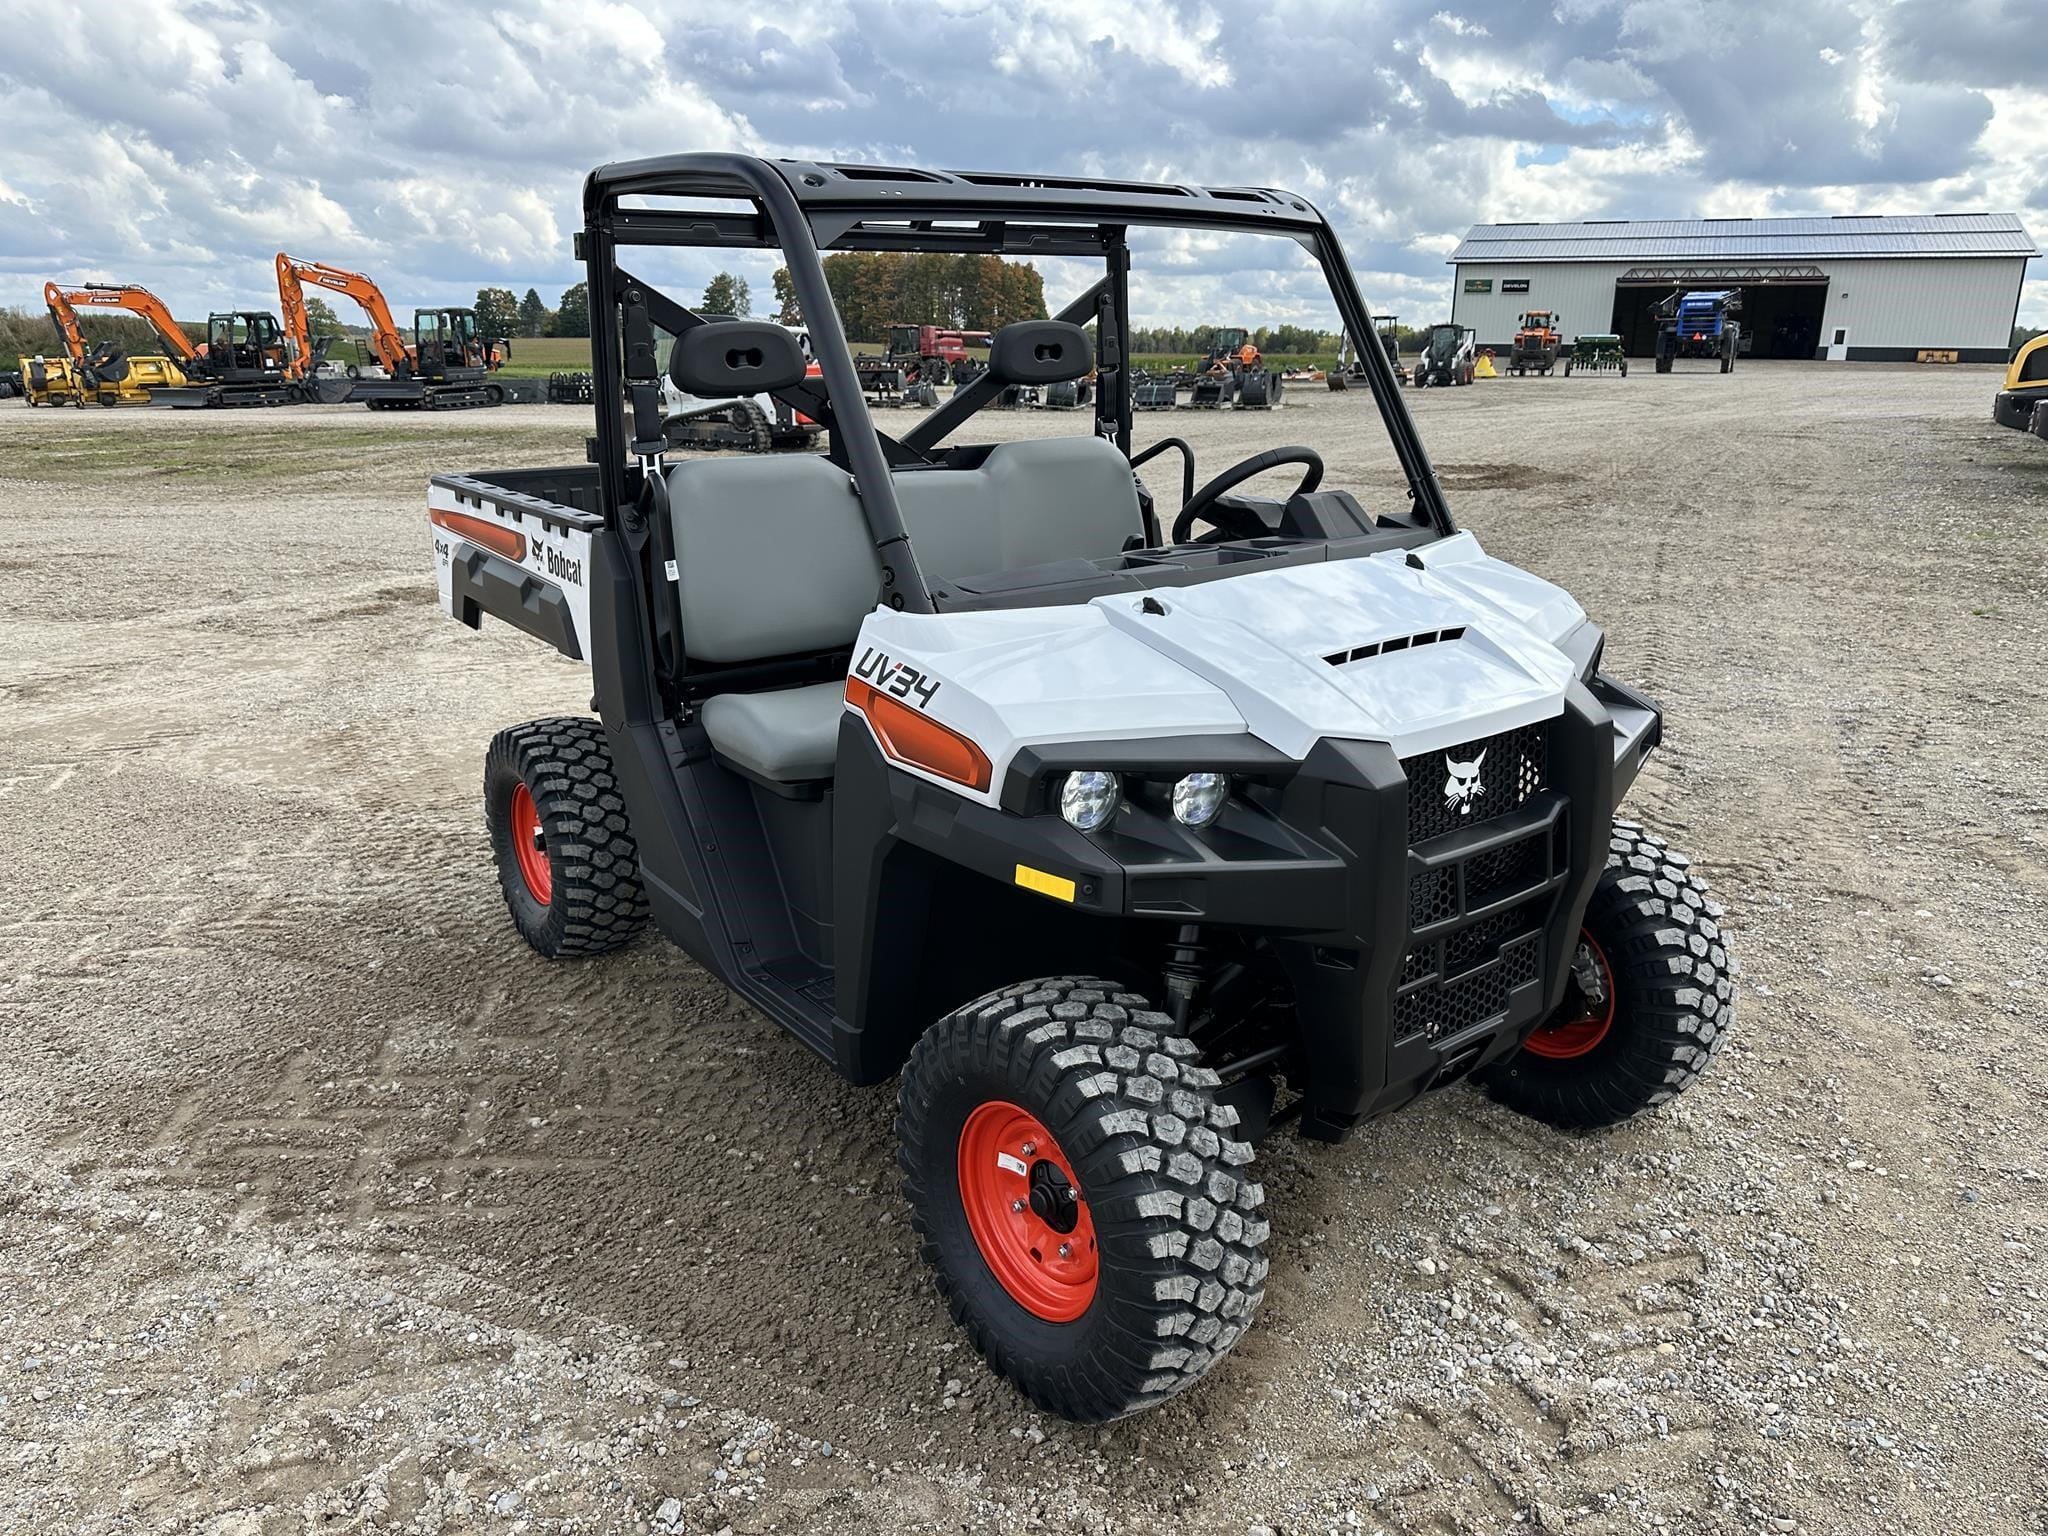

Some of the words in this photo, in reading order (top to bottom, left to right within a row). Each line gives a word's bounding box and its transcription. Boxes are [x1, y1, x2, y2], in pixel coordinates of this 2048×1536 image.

[435, 539, 449, 559] 4x4
[547, 545, 582, 587] Bobcat
[855, 647, 941, 709] UV34
